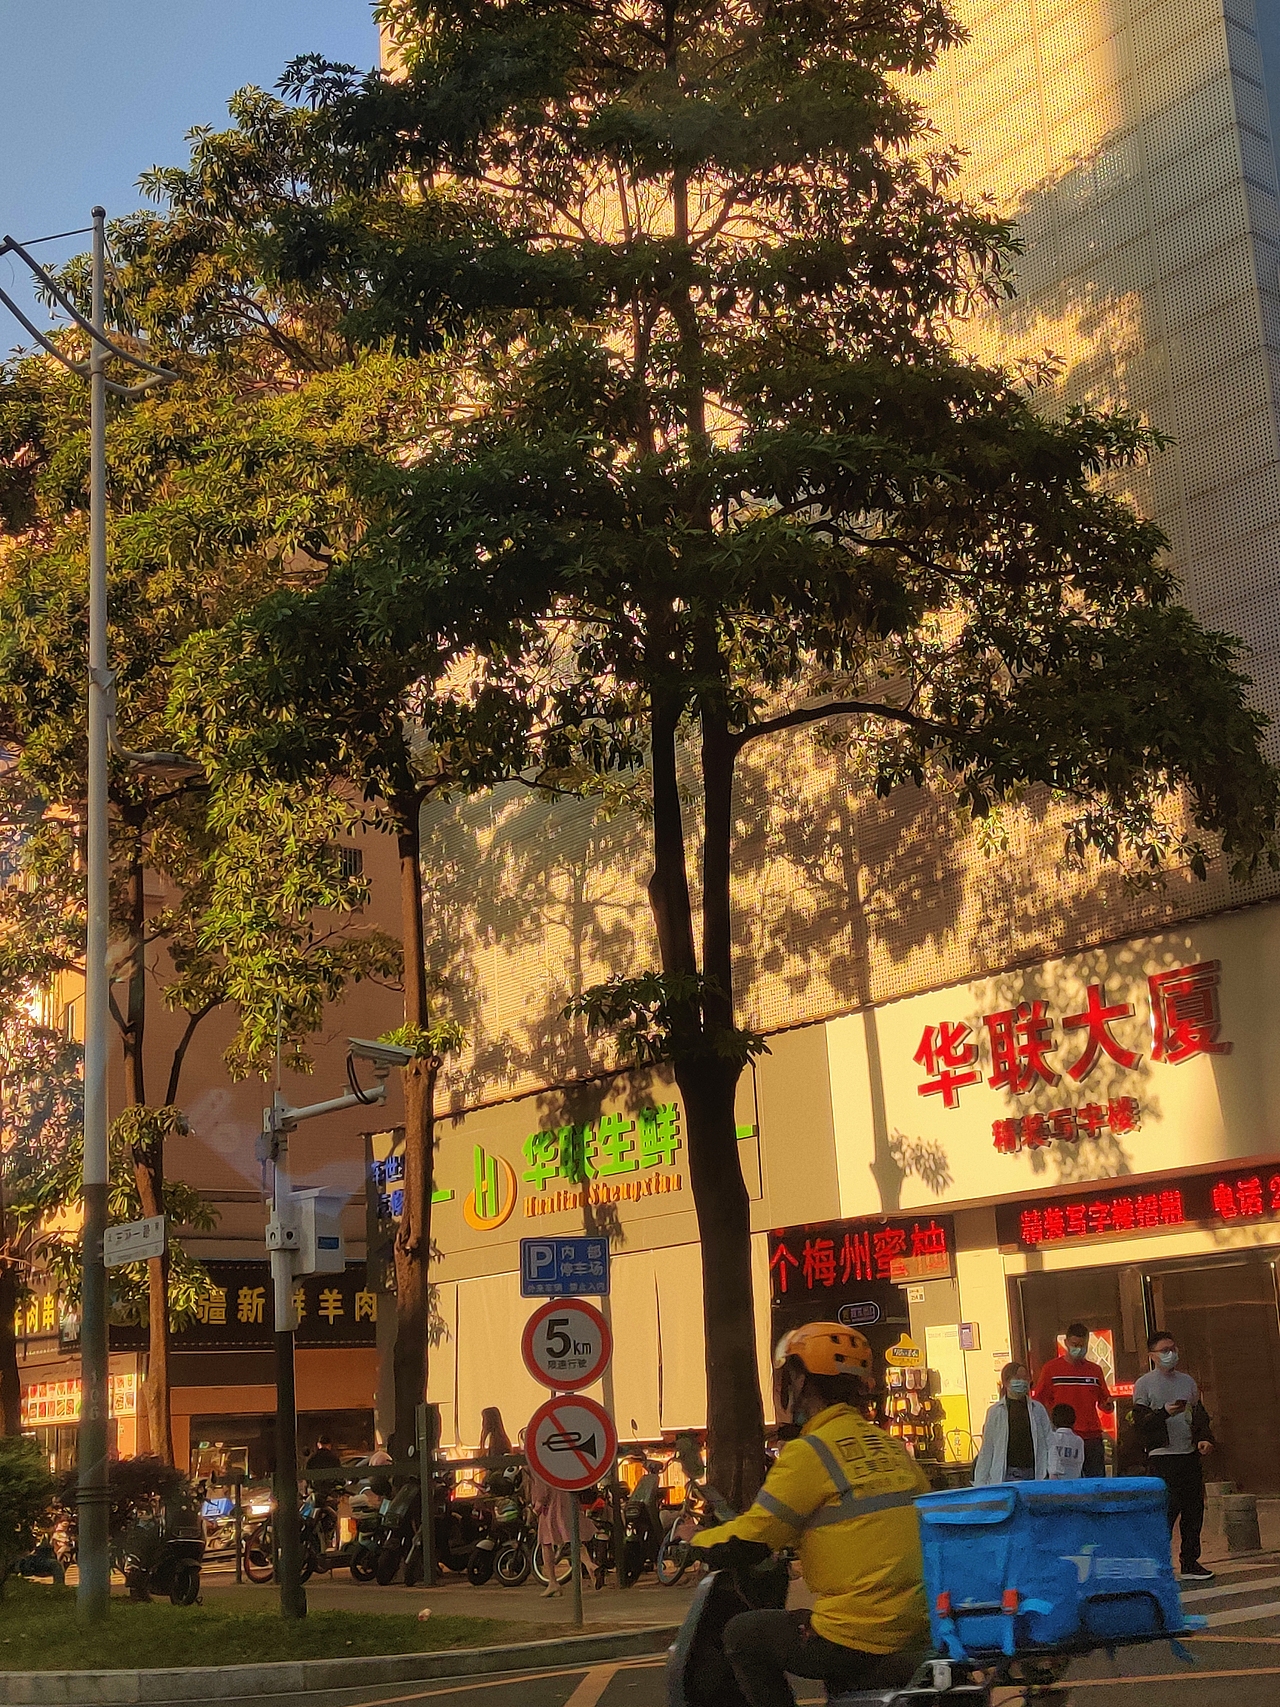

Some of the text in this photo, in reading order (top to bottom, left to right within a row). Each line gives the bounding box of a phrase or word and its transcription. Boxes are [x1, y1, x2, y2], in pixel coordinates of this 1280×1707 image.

[913, 960, 1233, 1109] 华联大厦
[522, 1102, 682, 1191] 华联生鲜
[991, 1096, 1141, 1154] 精装写字楼
[530, 1246, 553, 1278] P
[769, 1220, 948, 1293] 个梅州蜜柚
